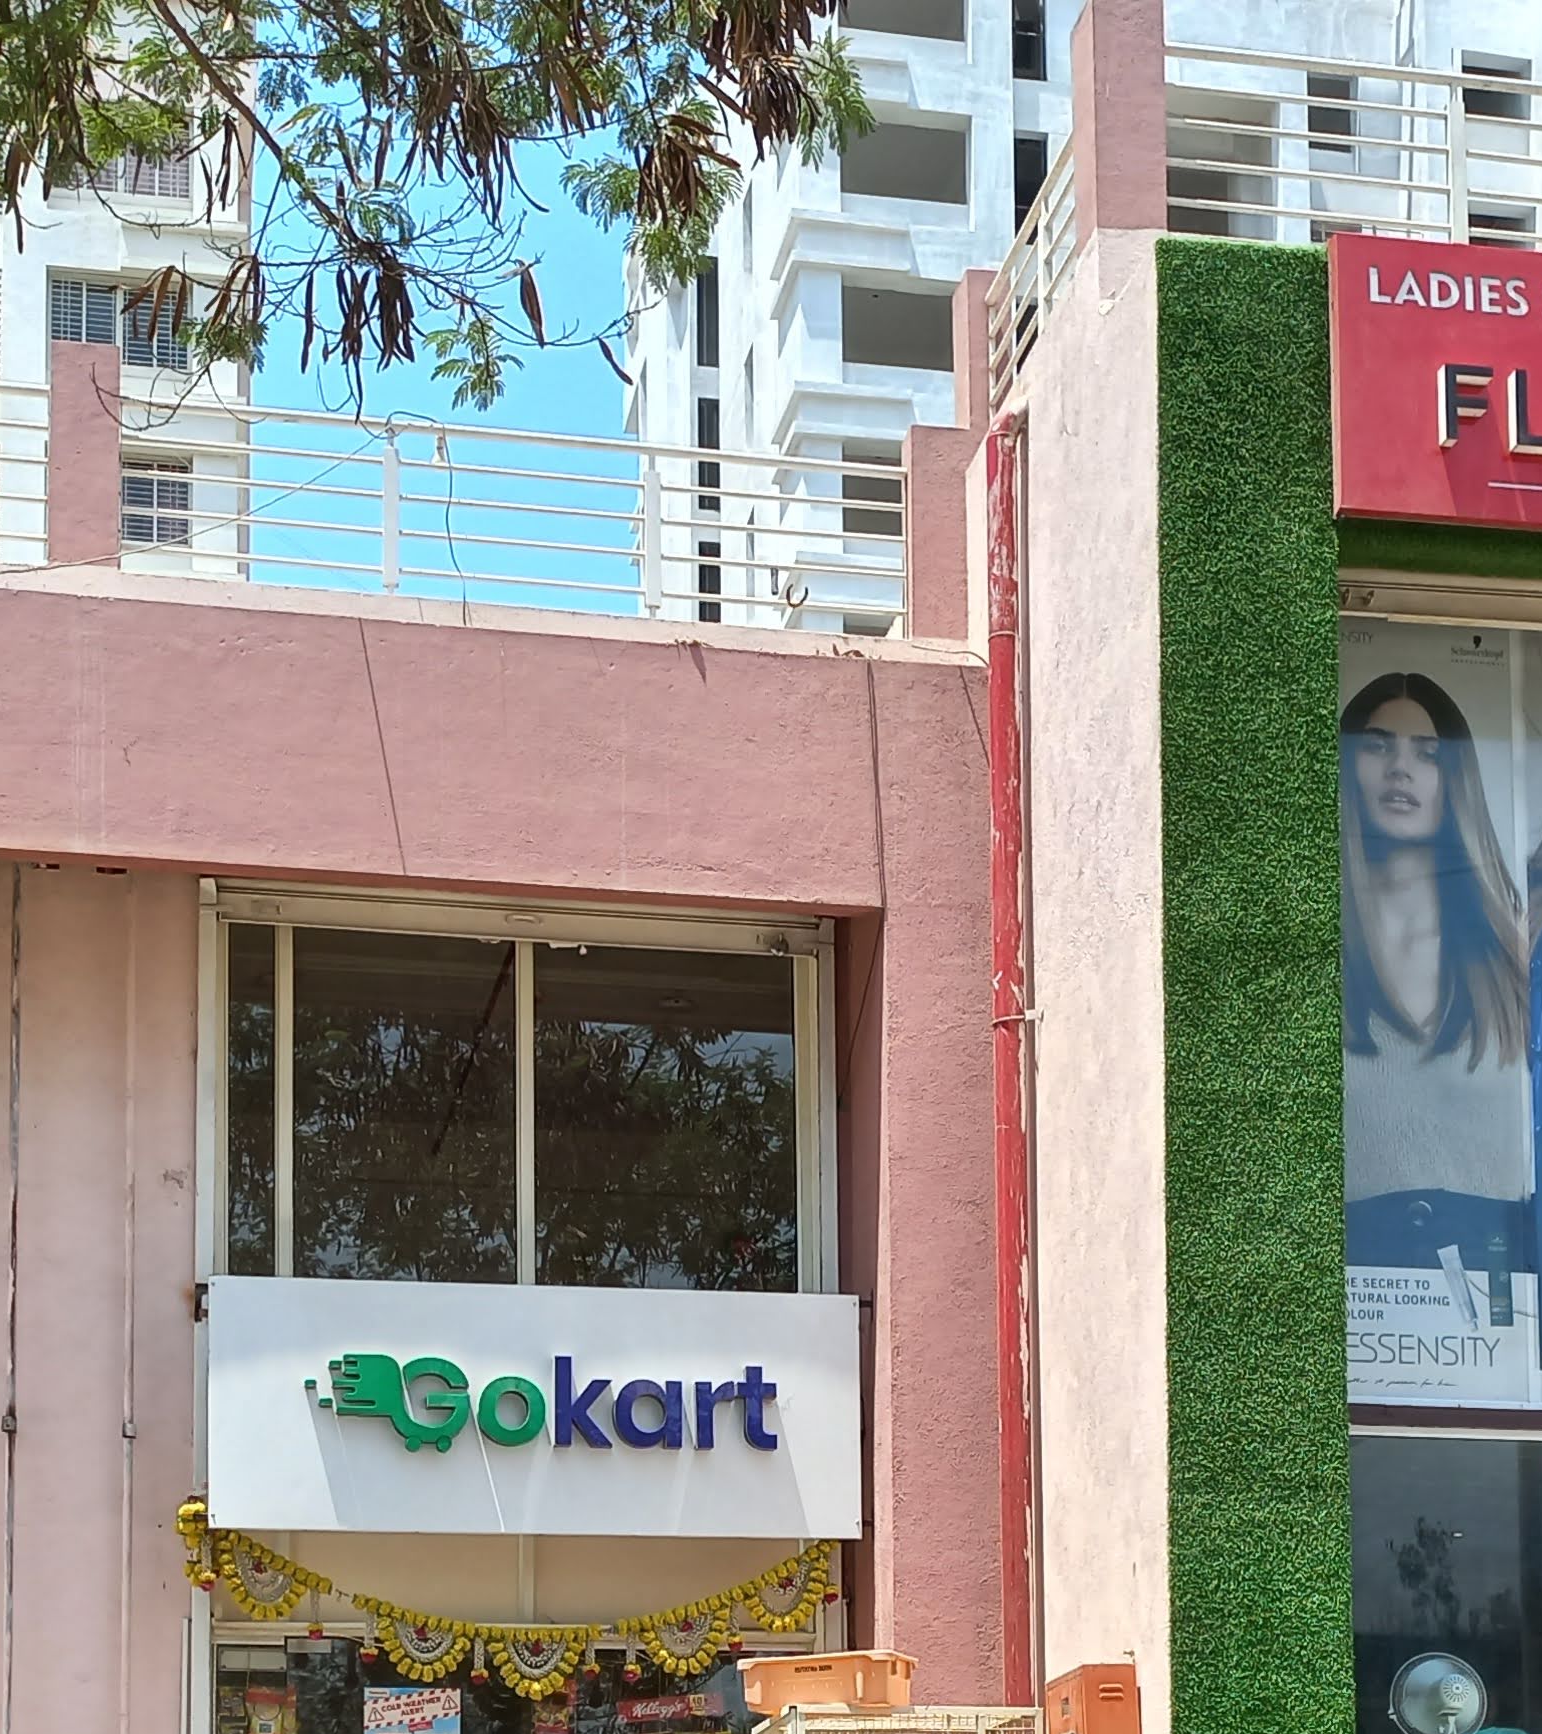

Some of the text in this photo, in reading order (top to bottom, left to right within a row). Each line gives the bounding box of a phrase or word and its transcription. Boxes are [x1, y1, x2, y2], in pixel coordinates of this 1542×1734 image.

[1368, 266, 1530, 317] LADIES
[1362, 1278, 1410, 1290] SECRET
[1414, 1279, 1430, 1290] TO
[1395, 1294, 1451, 1306] LOOKING
[394, 1354, 778, 1454] Gokart
